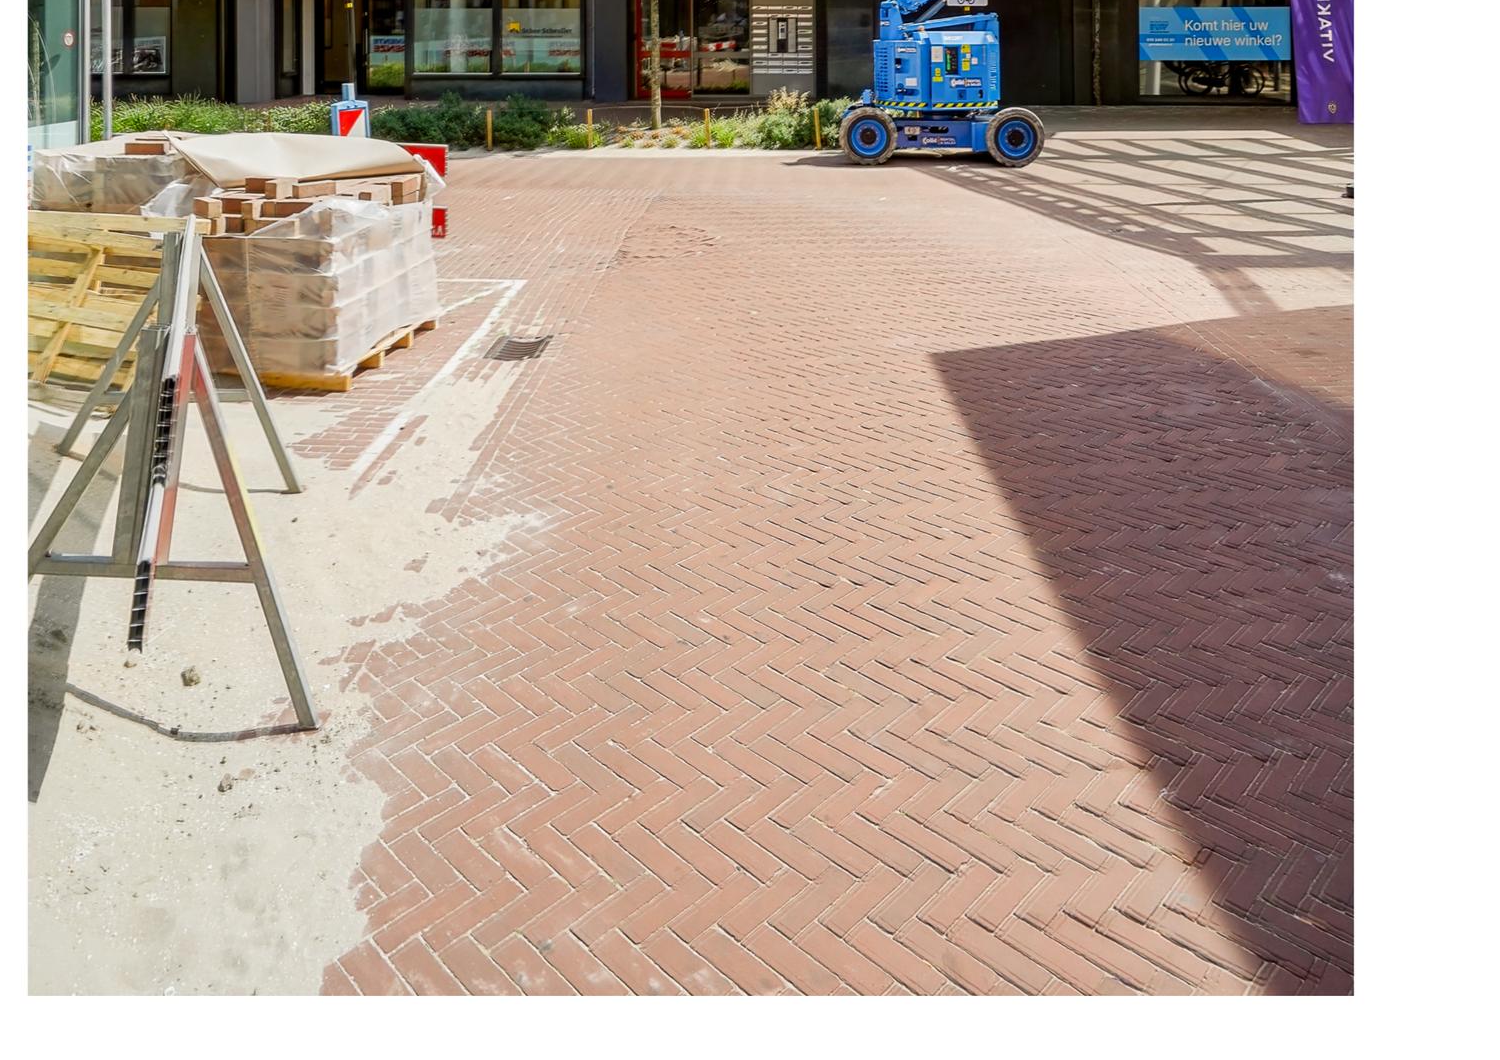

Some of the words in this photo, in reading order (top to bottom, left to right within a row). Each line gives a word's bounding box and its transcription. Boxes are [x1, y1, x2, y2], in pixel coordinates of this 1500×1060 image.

[1184, 19, 1218, 31] Komt
[1221, 19, 1246, 31] hier
[1249, 22, 1269, 31] uw
[1184, 34, 1231, 46] nieuwe
[1234, 34, 1282, 46] winkel?
